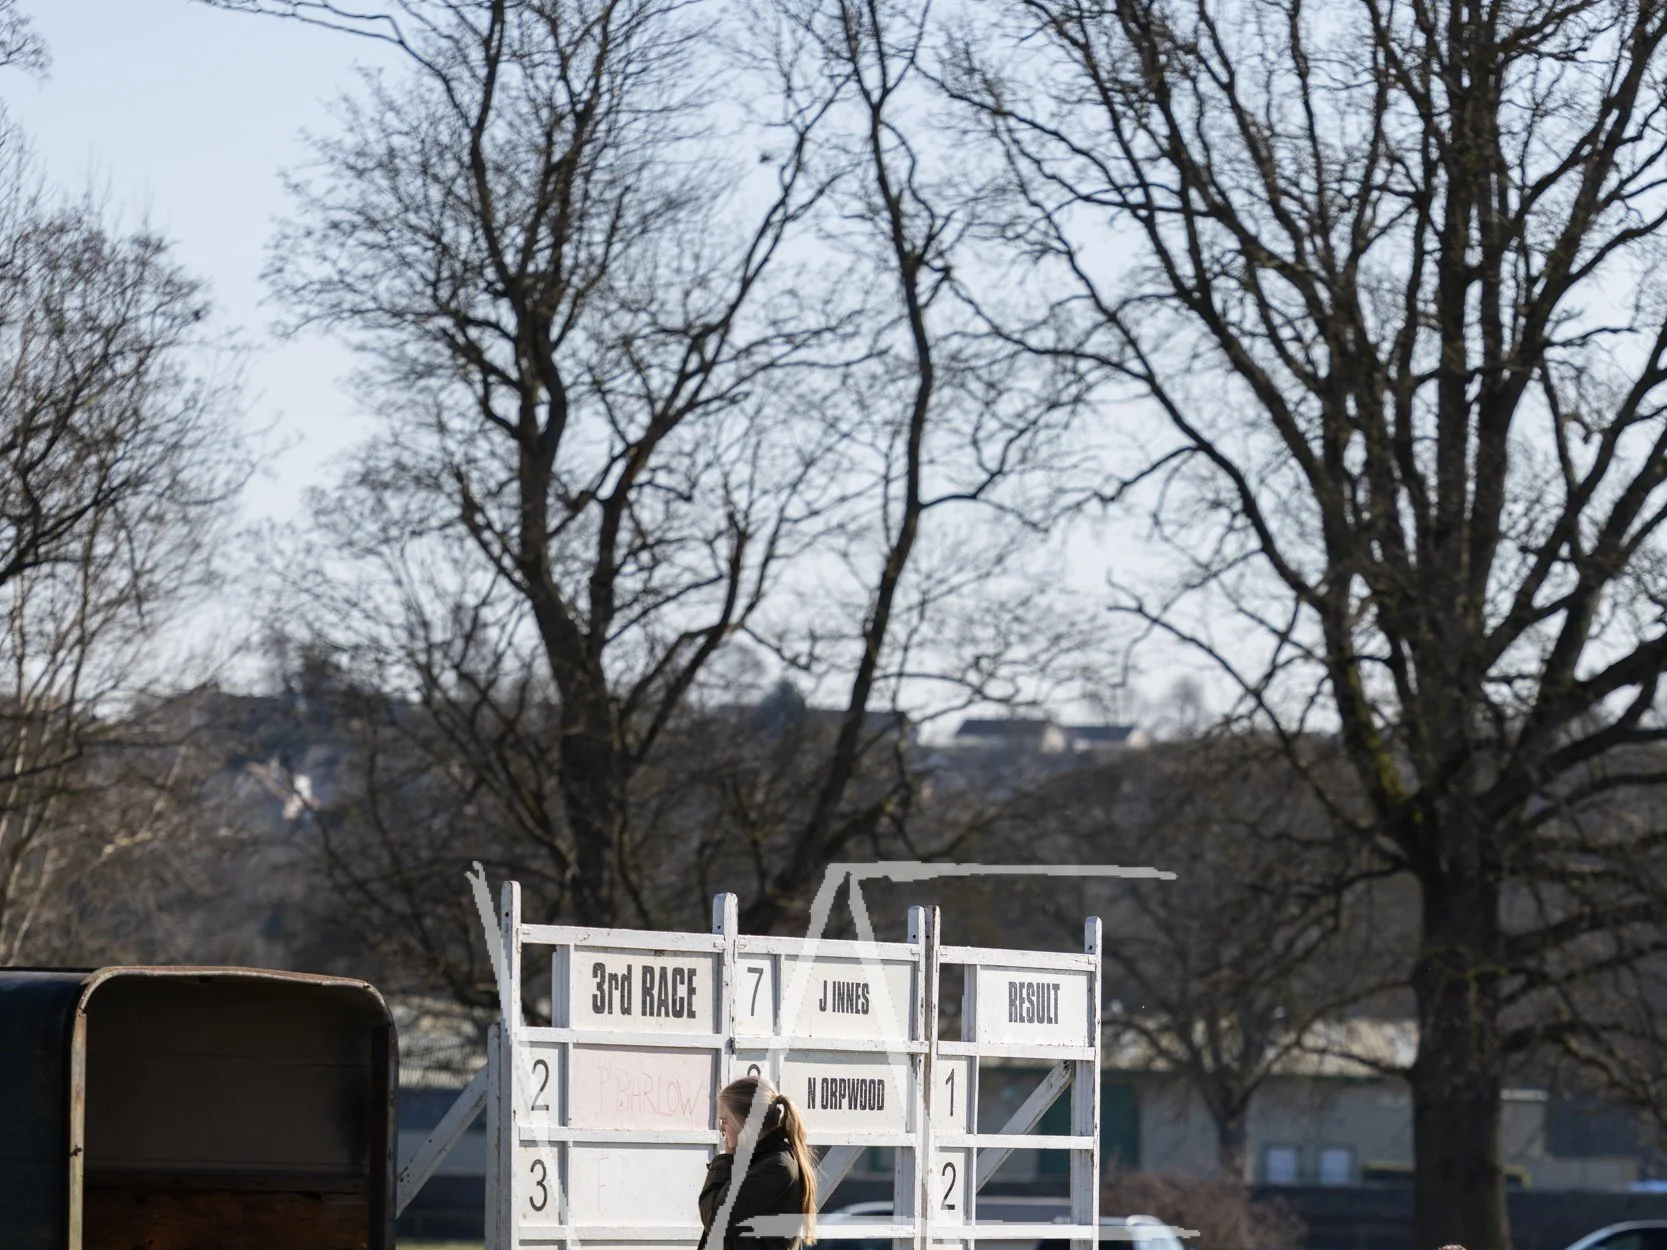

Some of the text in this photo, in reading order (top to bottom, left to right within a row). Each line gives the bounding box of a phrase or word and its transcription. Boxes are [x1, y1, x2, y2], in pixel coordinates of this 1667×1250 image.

[592, 962, 697, 1019] 3rd RACE
[746, 967, 764, 1017] 7
[818, 980, 870, 1015] J INNES
[1007, 980, 1061, 1025] RESULT
[530, 1058, 550, 1111] 2
[807, 1077, 885, 1111] N ORPWOOD
[944, 1068, 956, 1117] 1
[529, 1159, 548, 1212] 3
[940, 1162, 956, 1210] 2
